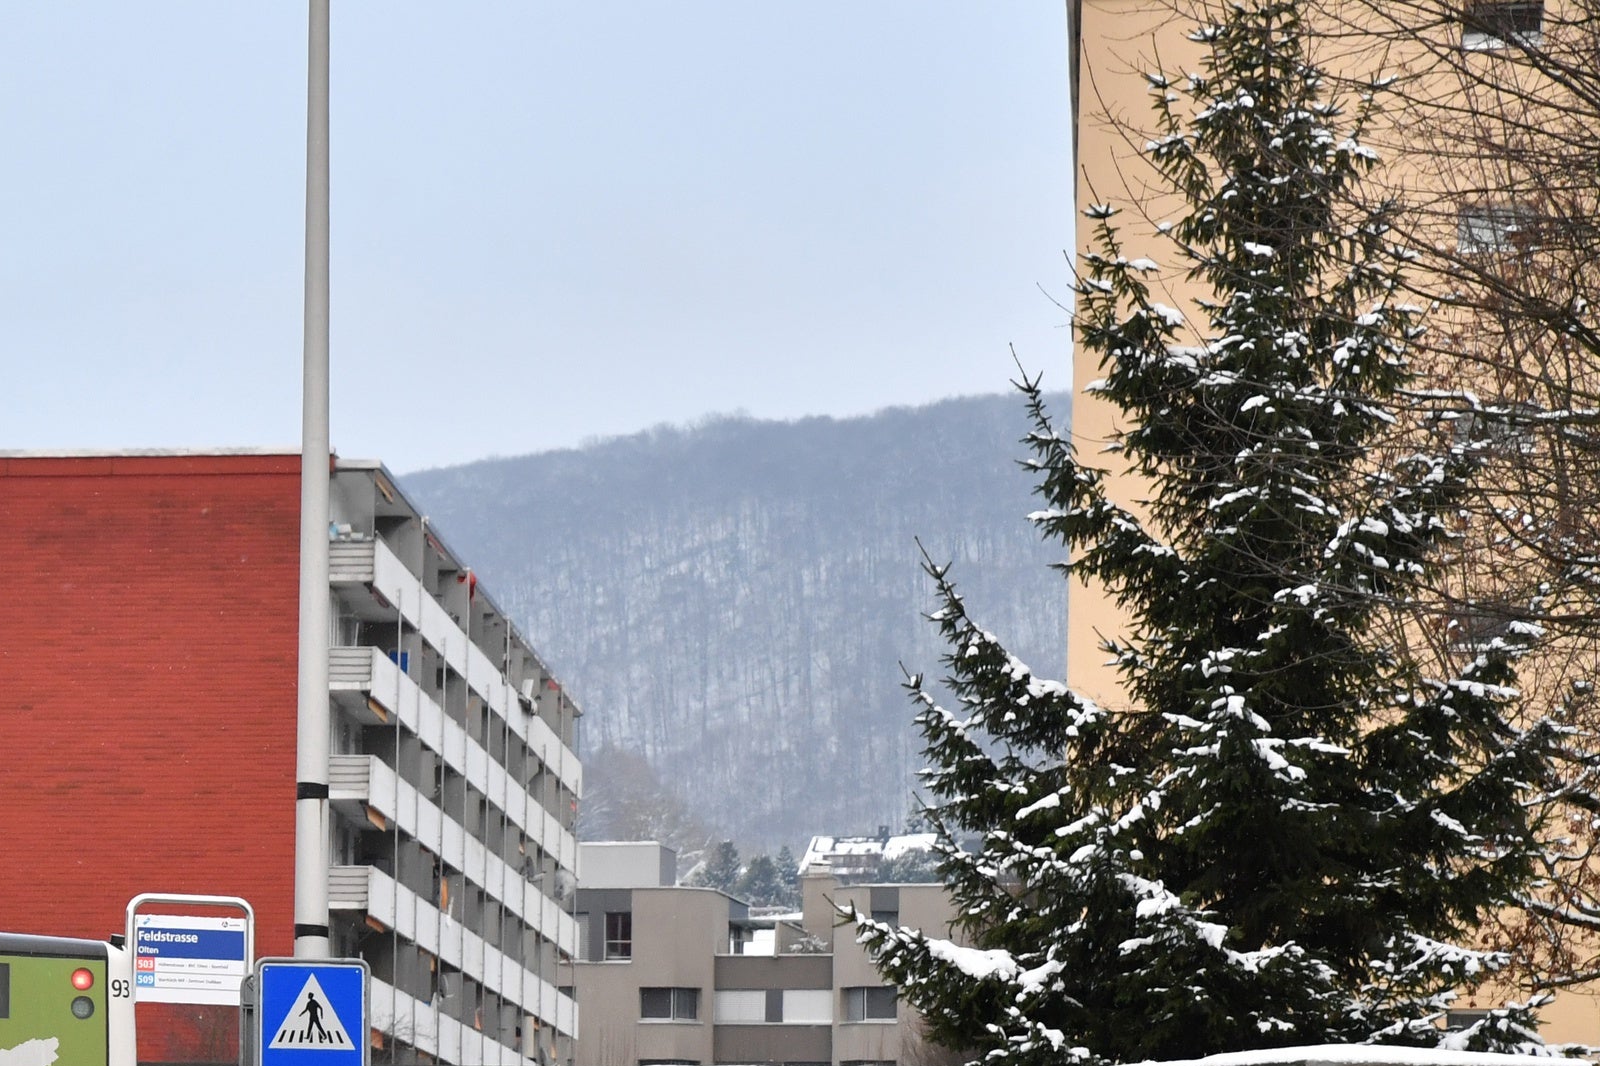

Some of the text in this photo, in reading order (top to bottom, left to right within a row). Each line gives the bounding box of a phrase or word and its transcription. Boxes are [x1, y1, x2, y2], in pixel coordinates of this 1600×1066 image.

[138, 930, 198, 943] Feldstrasse
[138, 946, 159, 954] Olten
[137, 959, 154, 968] 503
[137, 974, 154, 984] 509
[111, 979, 130, 998] 93
